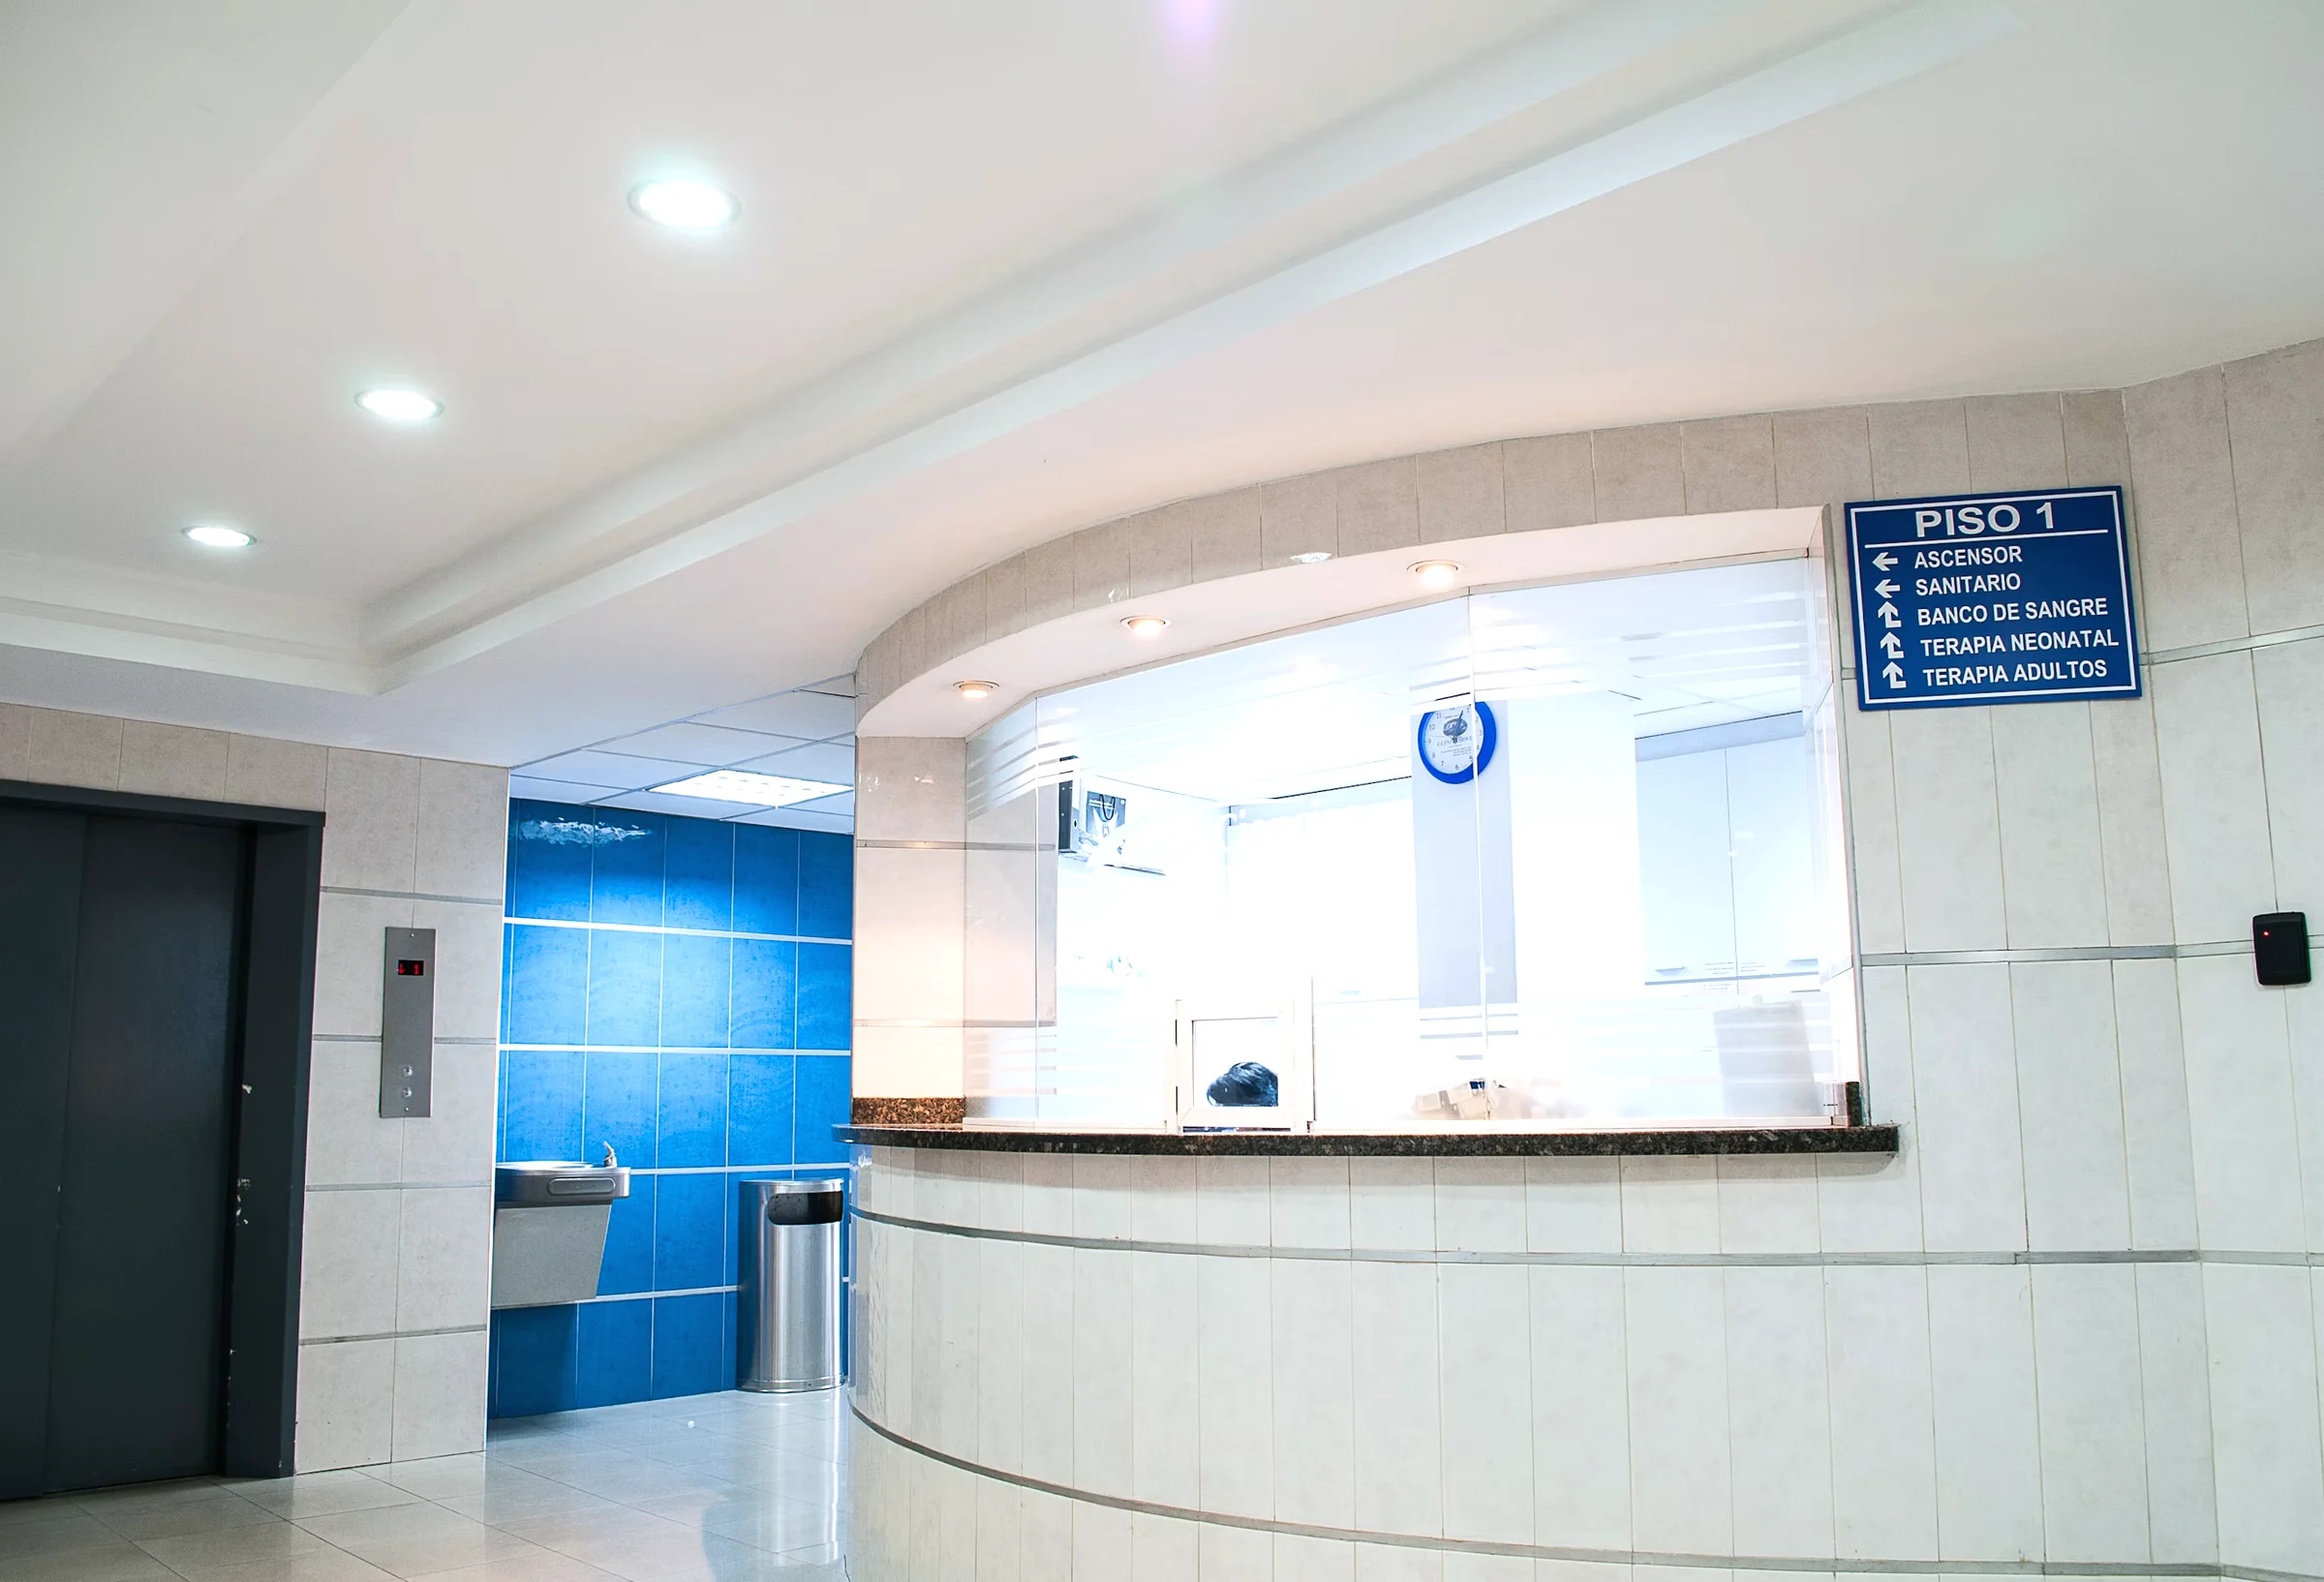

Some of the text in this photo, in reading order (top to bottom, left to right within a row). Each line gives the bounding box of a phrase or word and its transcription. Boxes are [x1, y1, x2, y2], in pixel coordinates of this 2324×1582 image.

[1915, 502, 2055, 537] PISO 1
[1914, 545, 2023, 569] ASCENSOR
[1915, 573, 2021, 596] SANITARIO
[1917, 597, 2108, 626] BANCO DE SANGRE
[1919, 628, 2120, 657] TERAPIA NEONATAL
[1922, 659, 2108, 686] TERAPIA ADULTOS
[413, 963, 419, 975] 1
